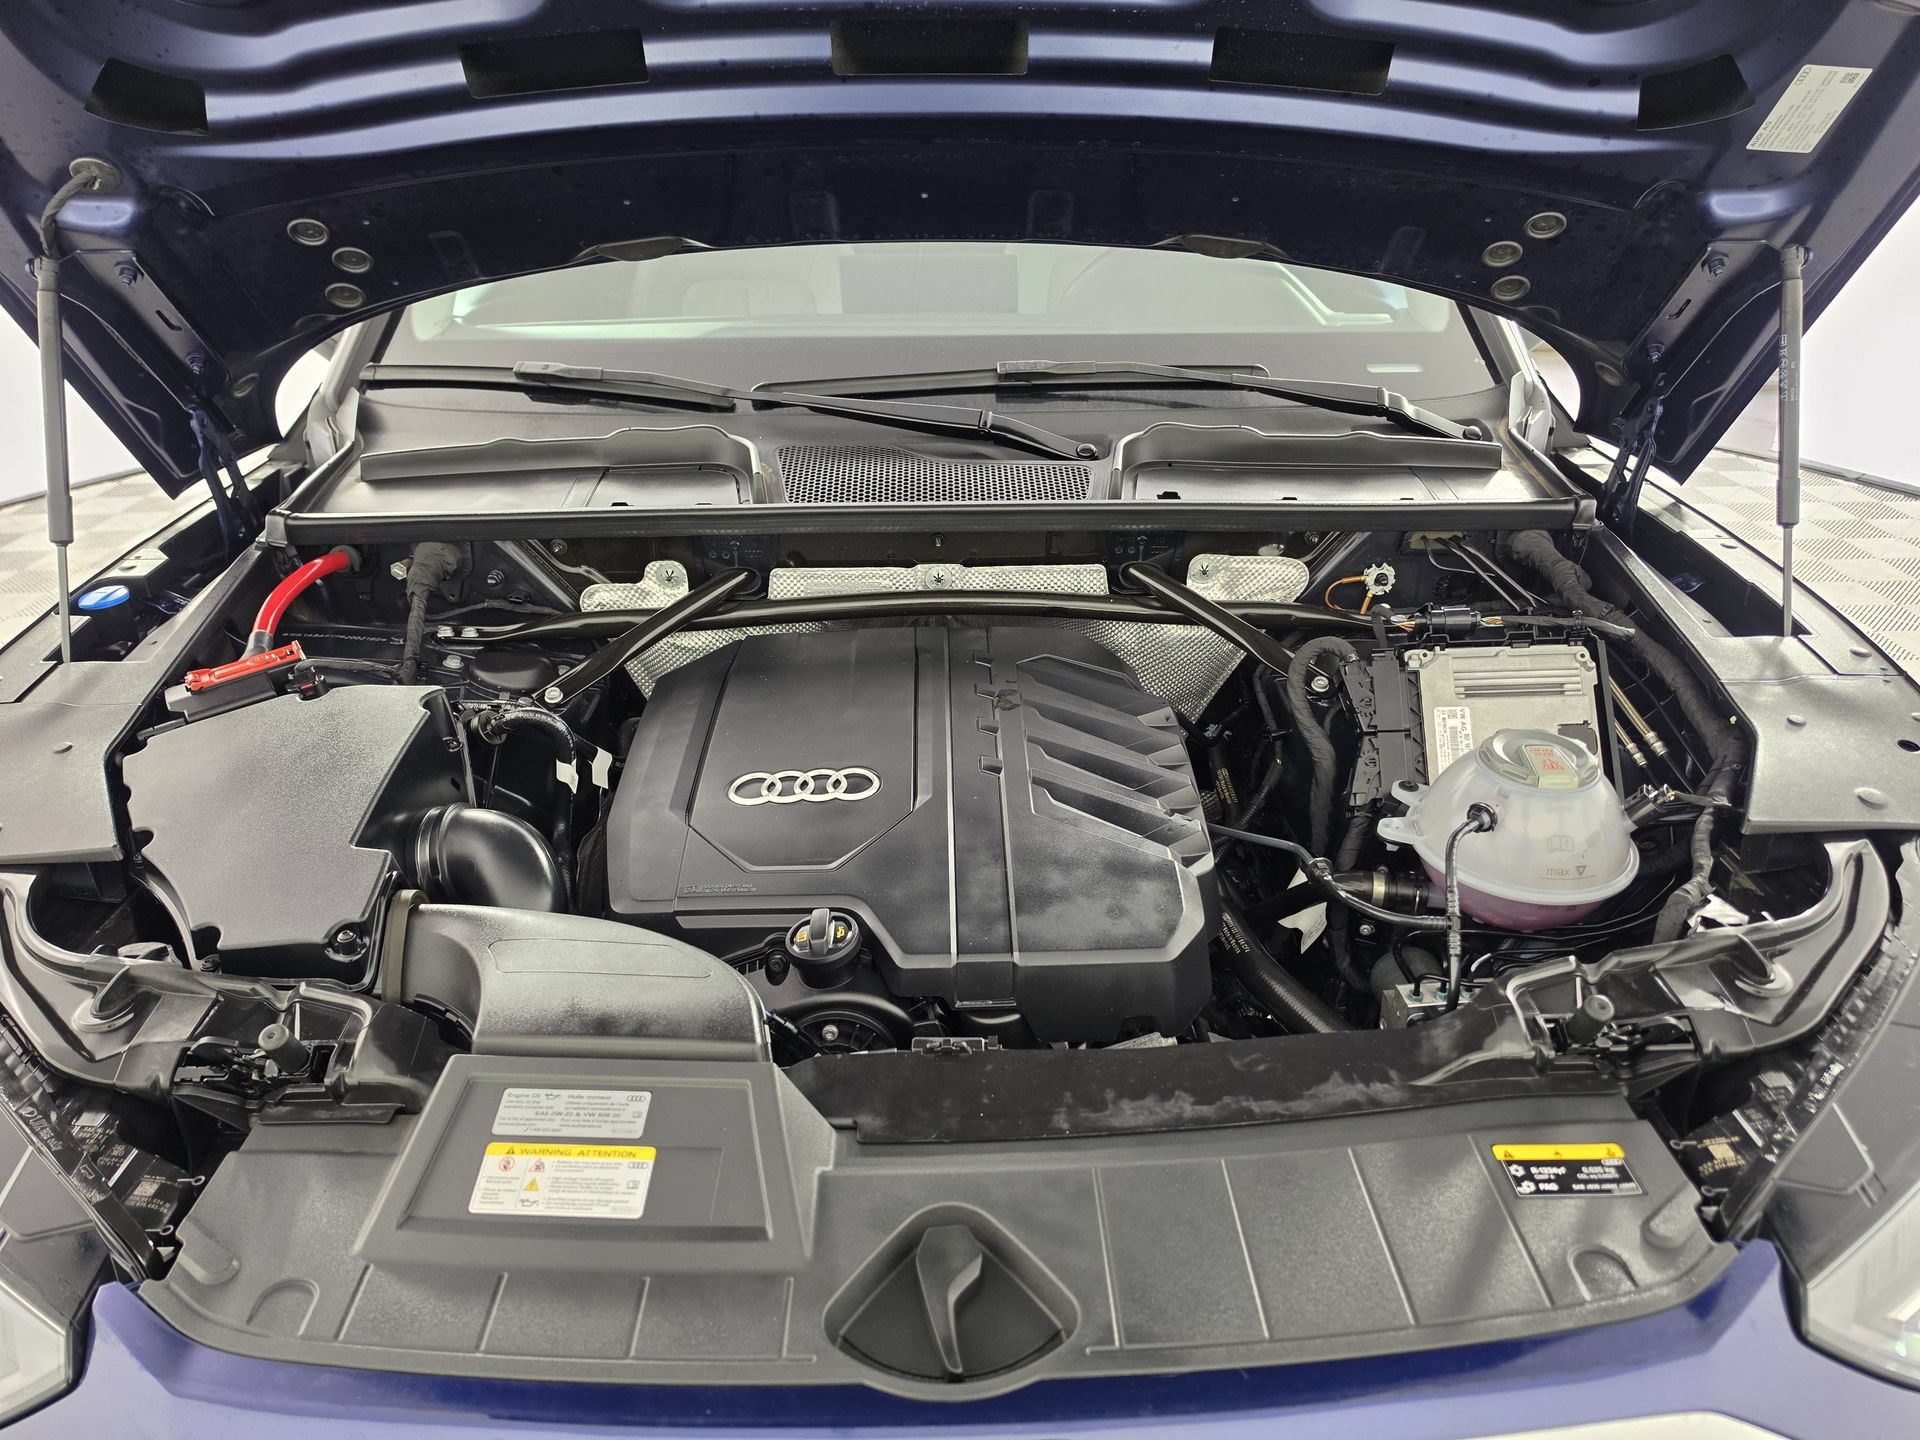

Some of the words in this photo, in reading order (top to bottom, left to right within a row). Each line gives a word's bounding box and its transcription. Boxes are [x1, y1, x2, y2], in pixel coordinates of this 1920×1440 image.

[1458, 708, 1467, 720] VW
[1460, 721, 1468, 732] AG
[1546, 868, 1569, 876] max
[519, 1148, 572, 1157] WARNING
[577, 1149, 637, 1158] ATTENTION
